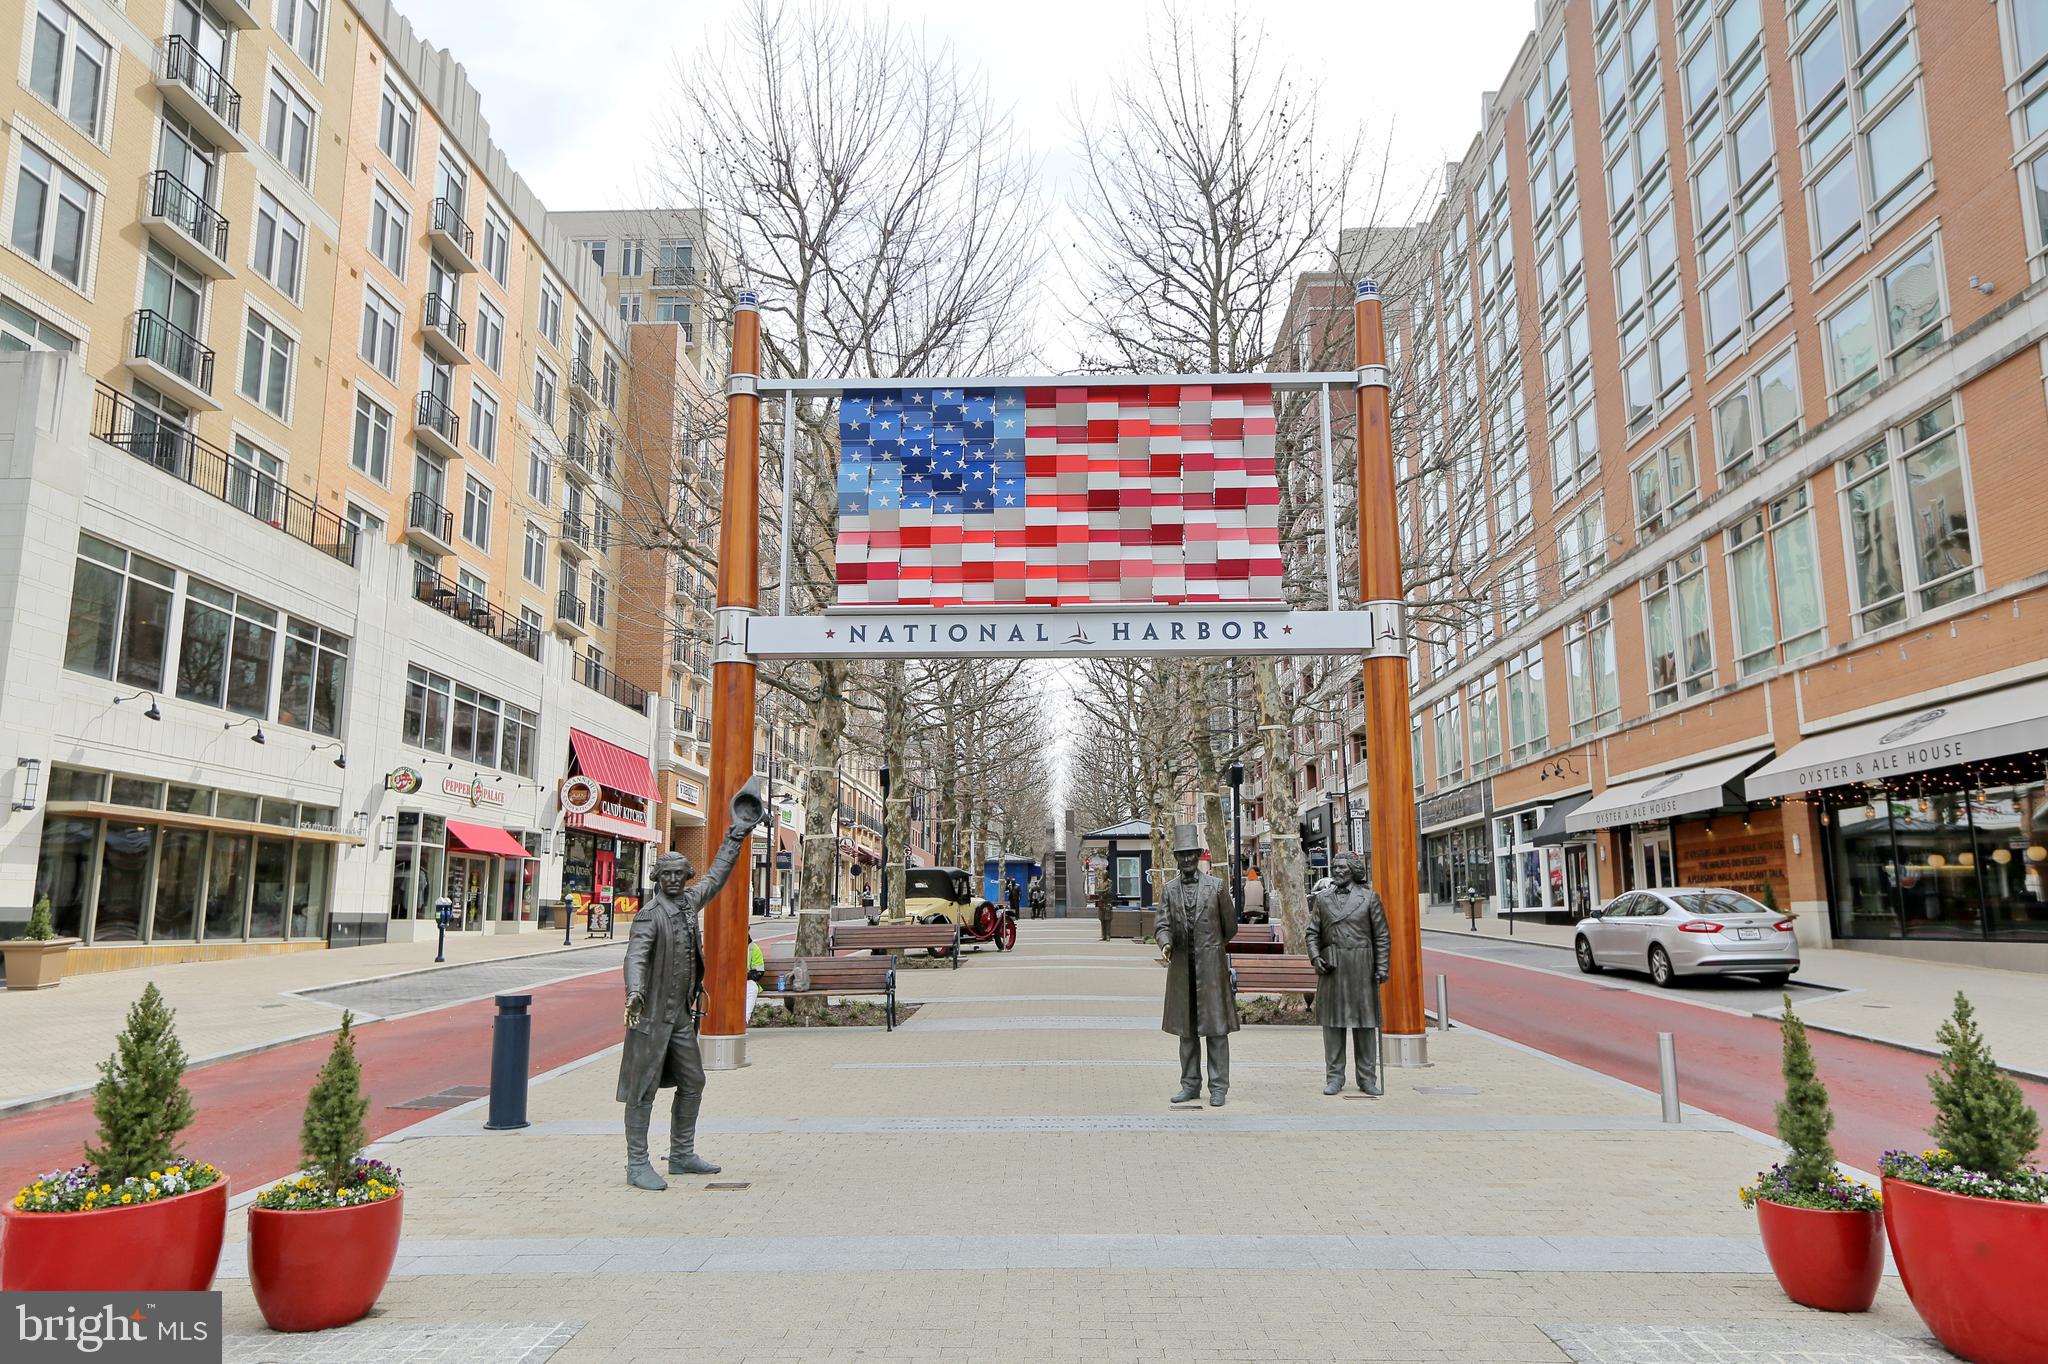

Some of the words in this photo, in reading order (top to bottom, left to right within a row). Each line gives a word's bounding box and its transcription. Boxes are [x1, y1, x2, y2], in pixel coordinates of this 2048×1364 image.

[849, 623, 1049, 643] NATIONAL
[1111, 621, 1269, 641] HARBOR
[1799, 765, 1849, 785] OYSTER
[1855, 762, 1864, 775] &
[1872, 755, 1900, 772] ALE
[1907, 742, 1963, 764] HOUSE
[445, 779, 471, 796] PEPPER
[483, 790, 505, 804] PALACE
[602, 801, 623, 818] CANDY
[623, 807, 648, 825] KITCHEN
[1595, 811, 1622, 824] OYSTER
[1625, 809, 1630, 820] &
[1632, 806, 1647, 818] ALE
[1650, 800, 1678, 814] HOUSE
